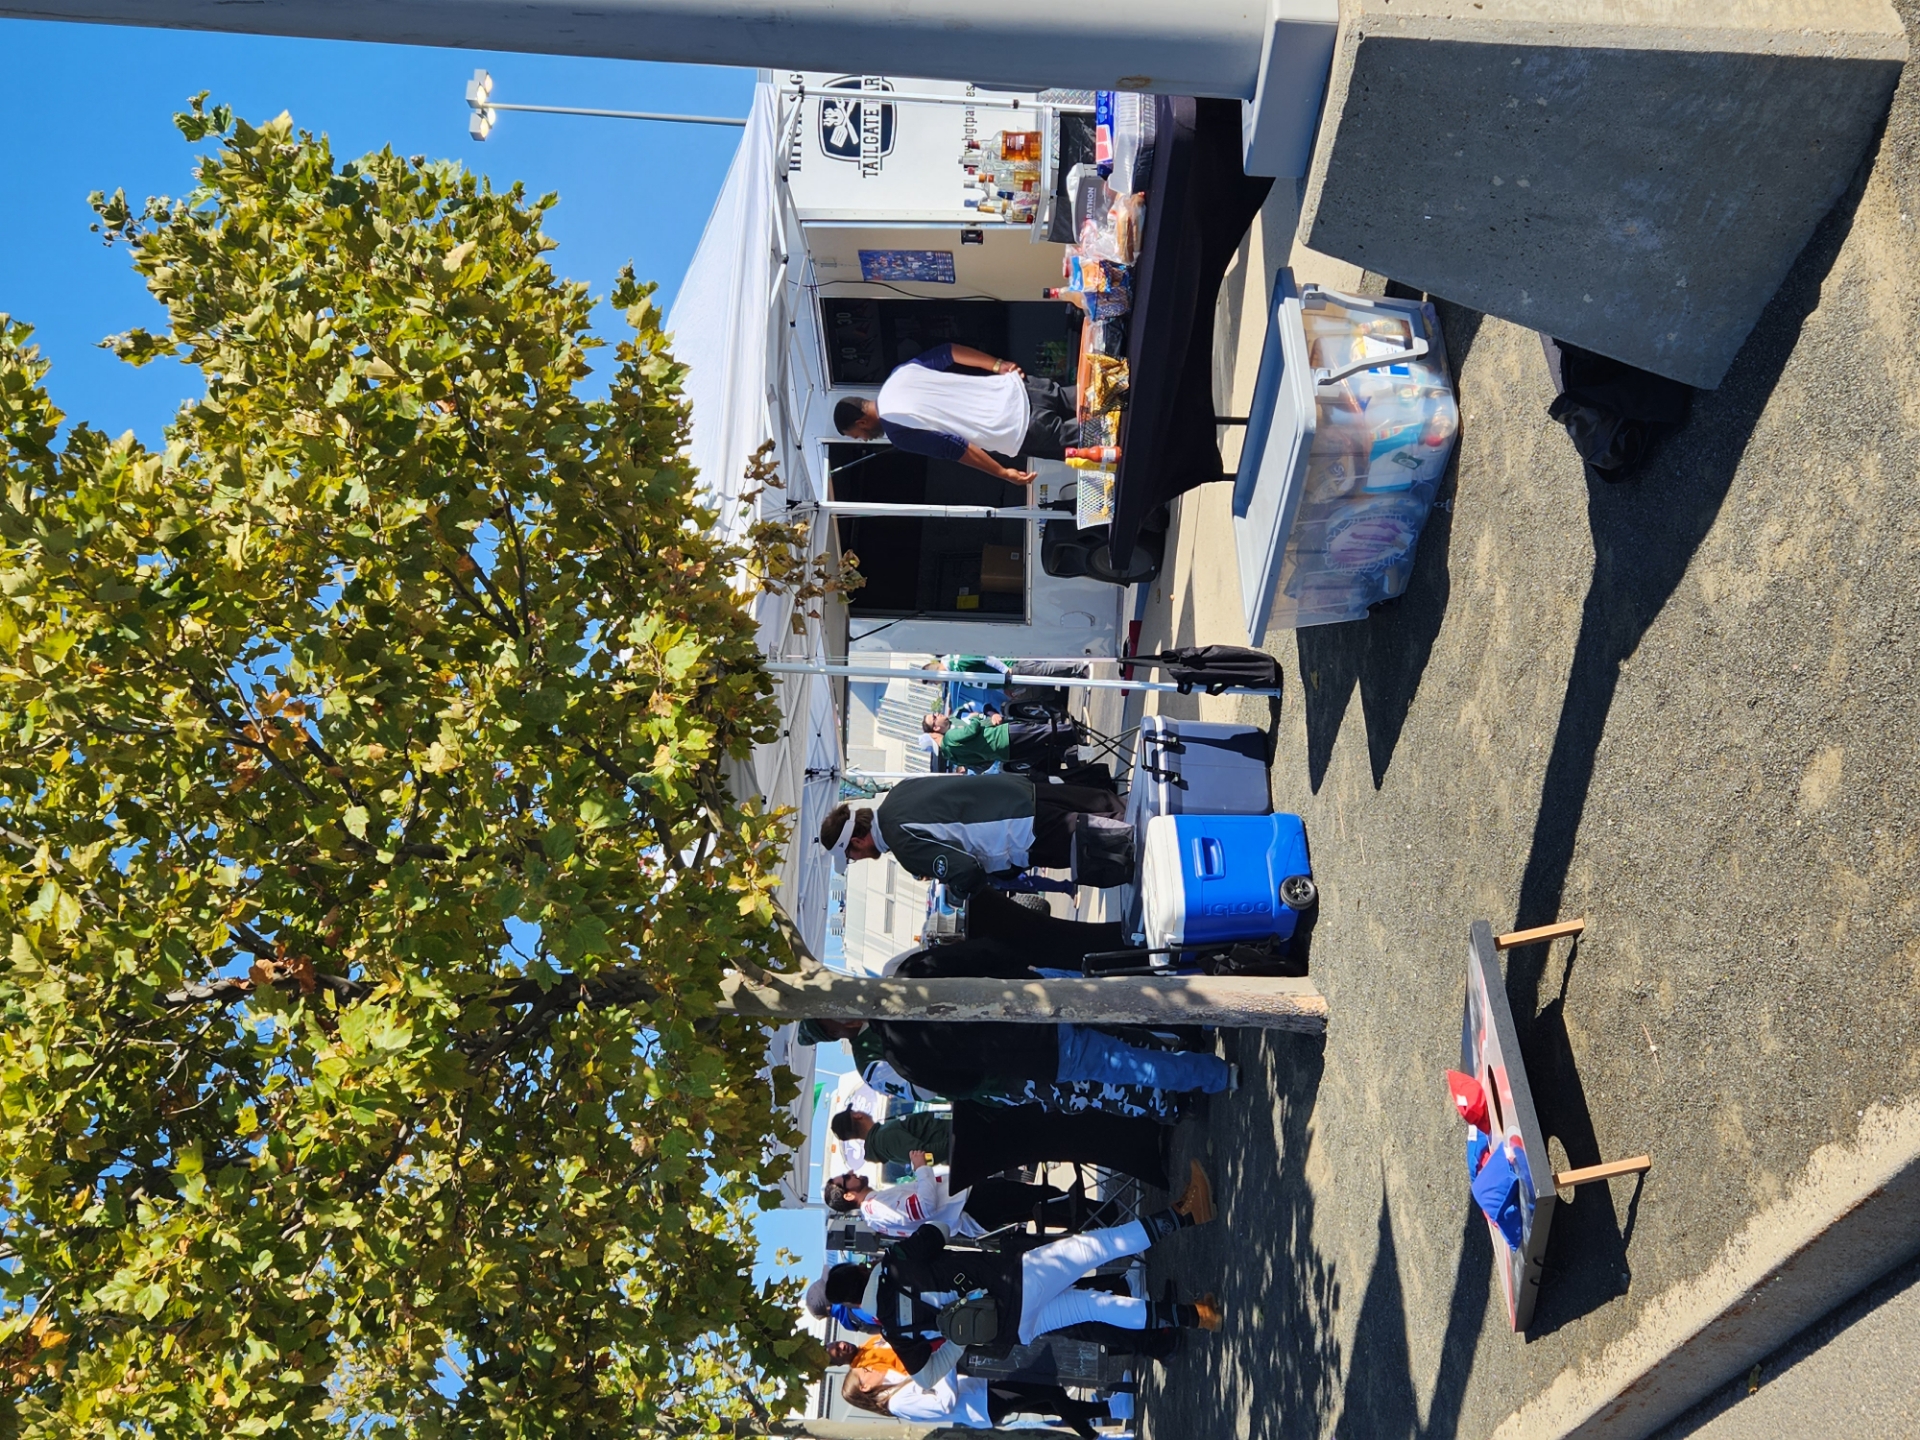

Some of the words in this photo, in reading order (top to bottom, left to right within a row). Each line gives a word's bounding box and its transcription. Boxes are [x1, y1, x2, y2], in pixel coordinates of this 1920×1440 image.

[863, 109, 880, 179] TAILGATE
[836, 312, 853, 325] 30
[841, 347, 858, 360] 40
[1204, 902, 1271, 915] IGLOO
